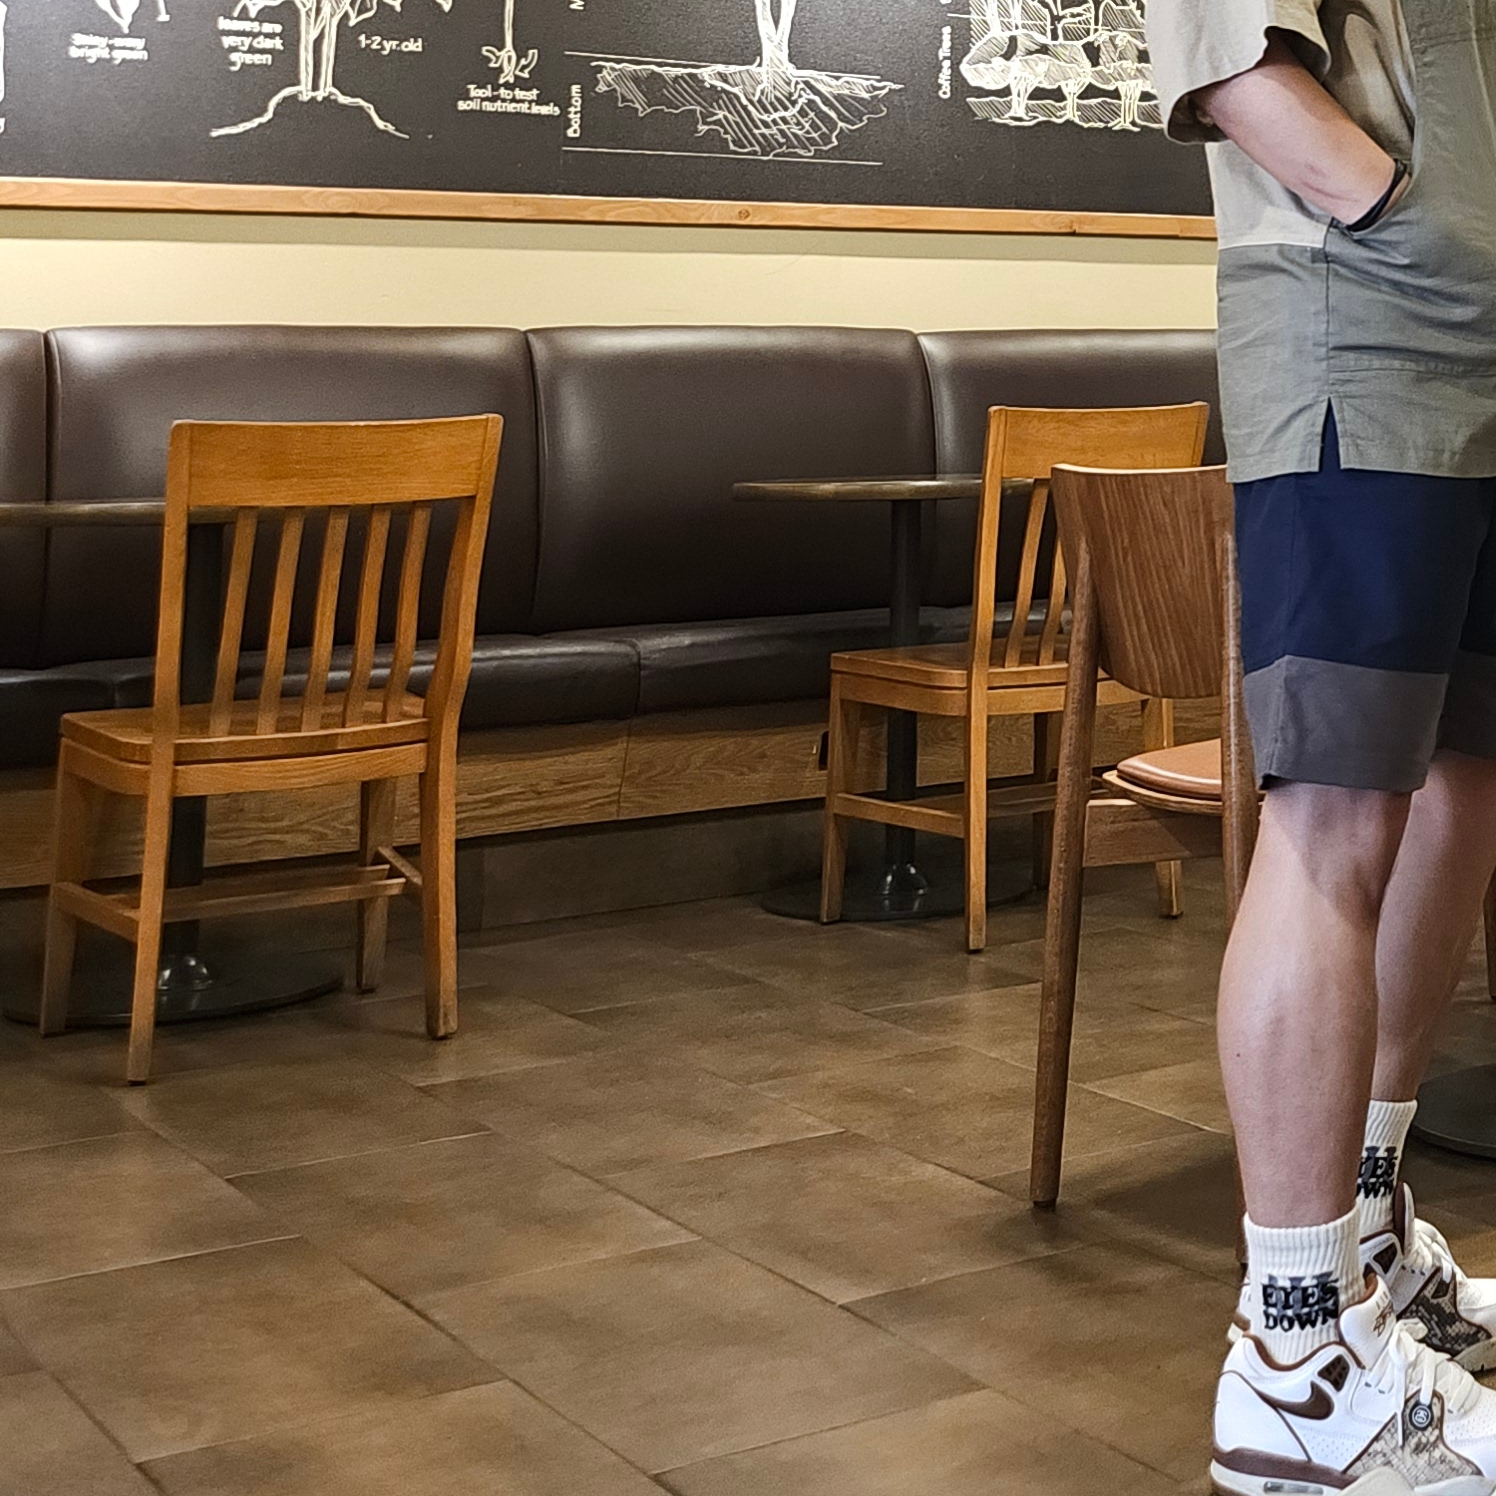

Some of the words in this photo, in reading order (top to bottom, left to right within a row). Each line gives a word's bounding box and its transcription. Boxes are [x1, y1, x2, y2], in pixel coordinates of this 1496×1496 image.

[221, 36, 252, 51] very
[252, 35, 284, 50] dark
[938, 25, 952, 60] Trees
[229, 52, 272, 71] green
[938, 60, 951, 99] Coffee
[457, 98, 481, 111] soil
[481, 100, 531, 113] nutrient
[514, 88, 540, 101] test
[566, 84, 582, 138] Bottom
[1357, 1155, 1398, 1179] YES
[1261, 1278, 1339, 1310] EYES
[1263, 1305, 1338, 1332] DOWN
